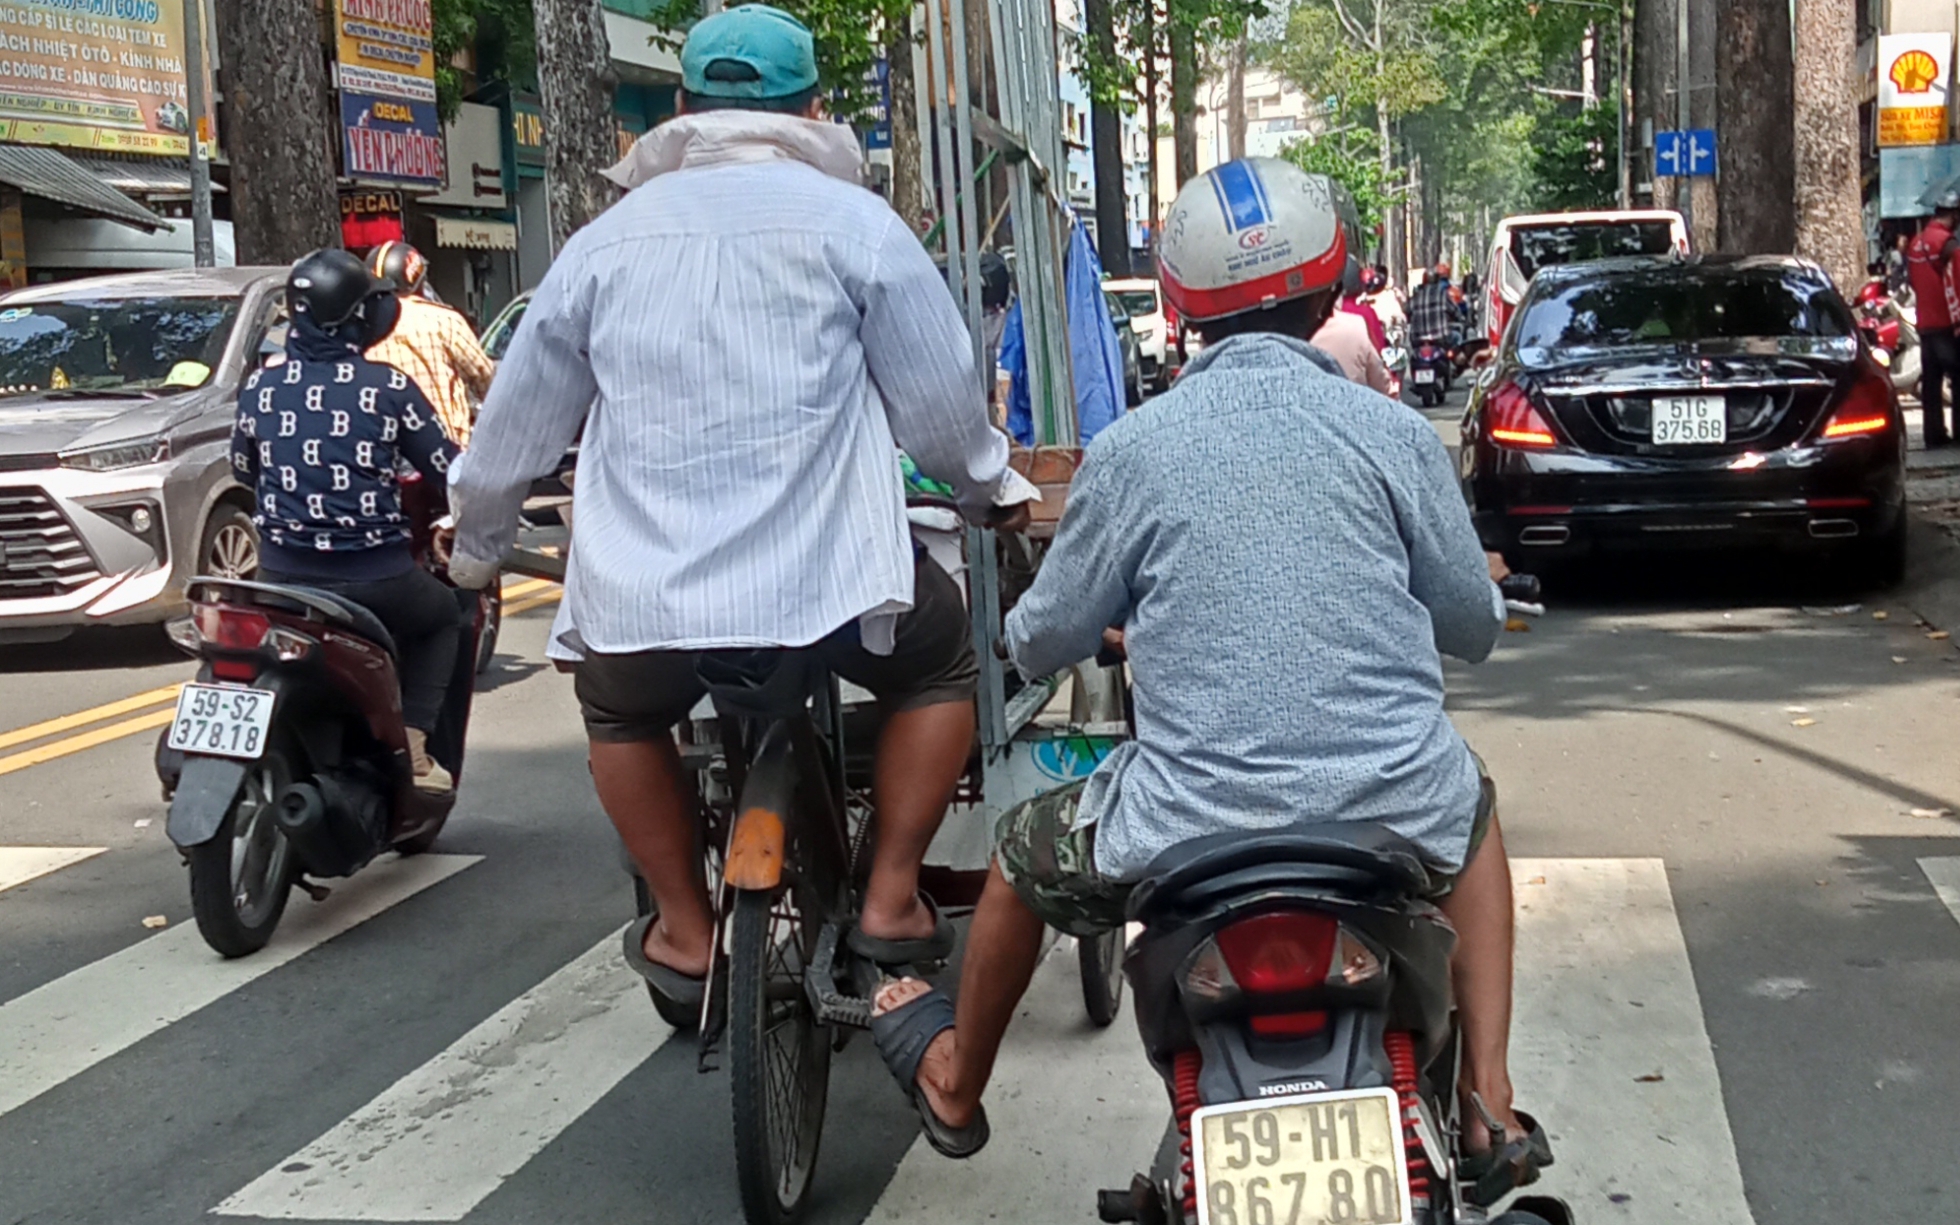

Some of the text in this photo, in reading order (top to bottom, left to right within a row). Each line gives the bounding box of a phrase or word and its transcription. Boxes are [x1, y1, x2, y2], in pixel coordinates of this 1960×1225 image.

[33, 36, 78, 62] NHIỆT
[49, 65, 66, 83] XE
[374, 102, 414, 123] DECAL
[341, 193, 400, 213] DECAL
[1670, 397, 1708, 419] 51G
[1656, 419, 1722, 441] 375.68
[191, 690, 259, 723] 59-S2
[176, 717, 261, 753] 378.18
[1258, 1080, 1328, 1096] HONDA
[1222, 1102, 1361, 1170] 59-H1
[1208, 1164, 1396, 1225] 867.80
